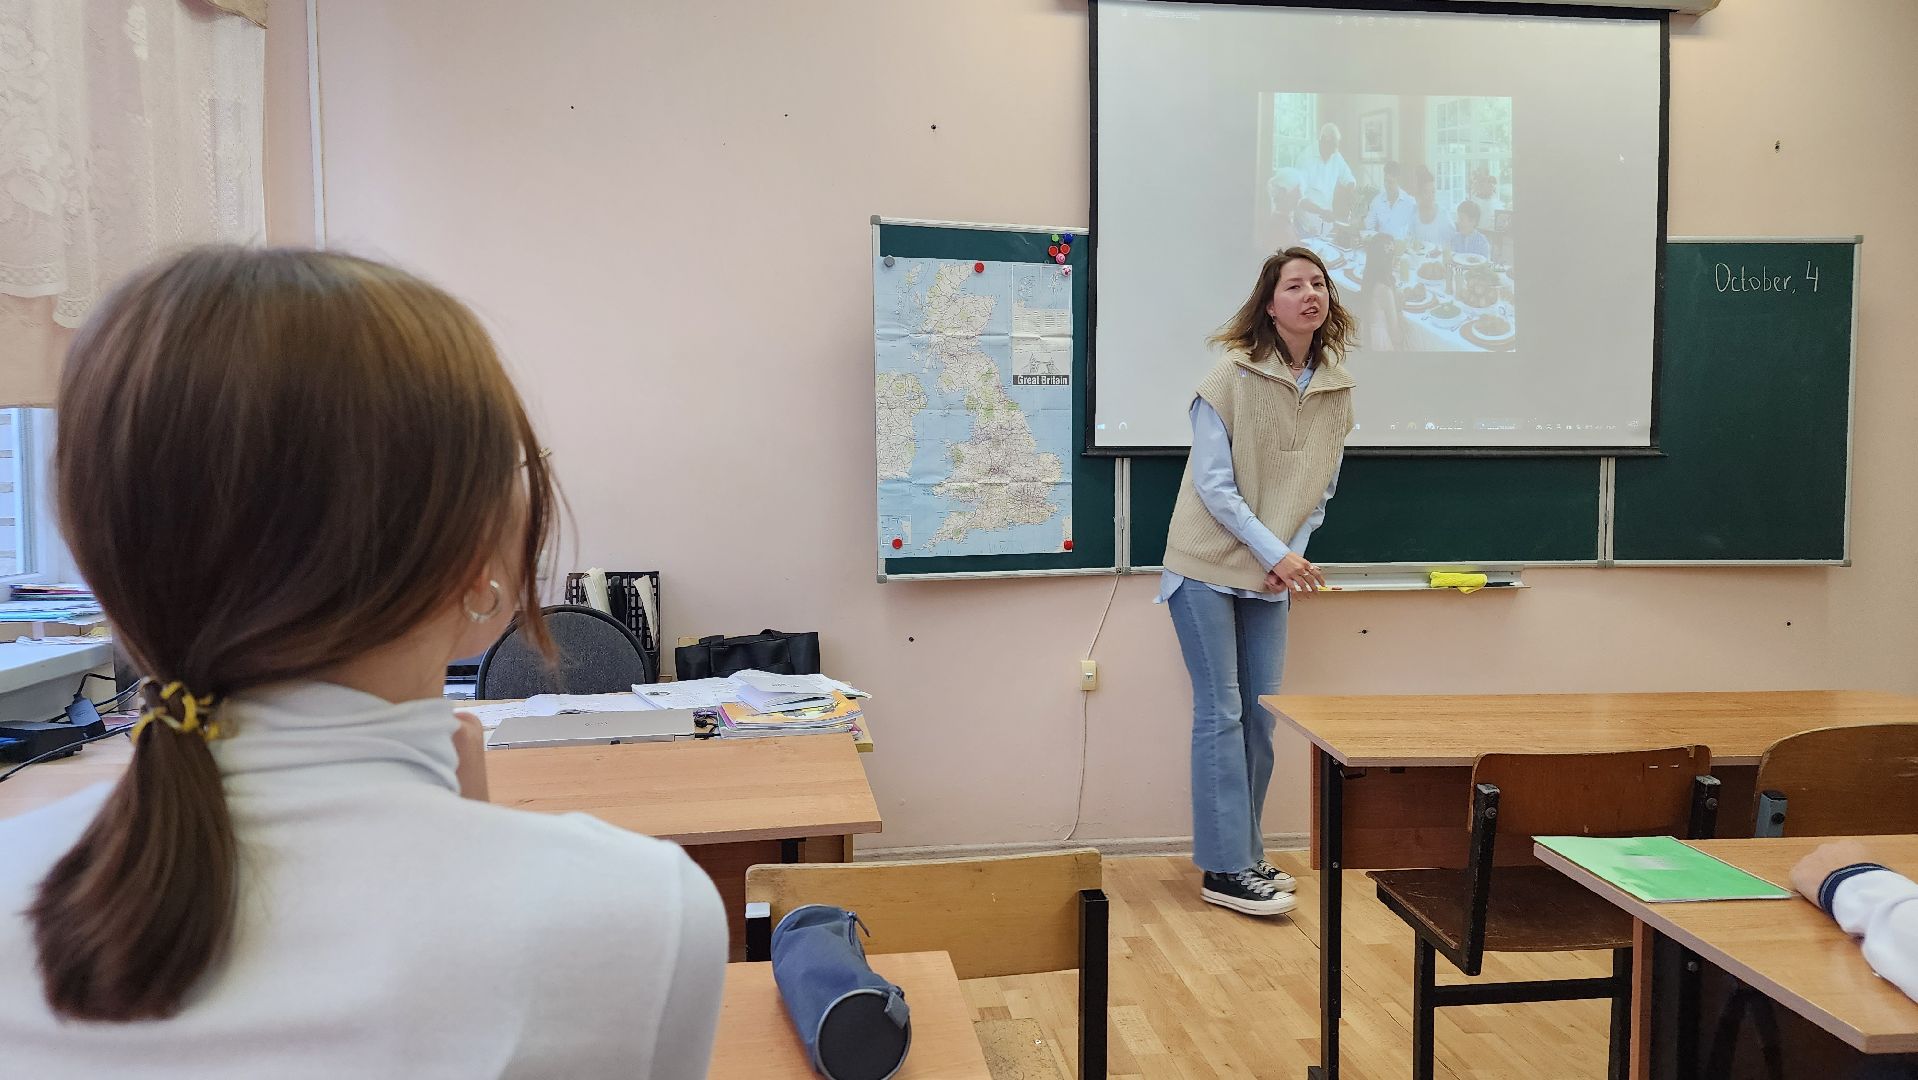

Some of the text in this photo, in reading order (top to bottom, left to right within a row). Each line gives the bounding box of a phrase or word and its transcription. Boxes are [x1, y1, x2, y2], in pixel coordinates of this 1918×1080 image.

[1714, 260, 1820, 294] October, 4
[1017, 375, 1068, 385] Great Britain
